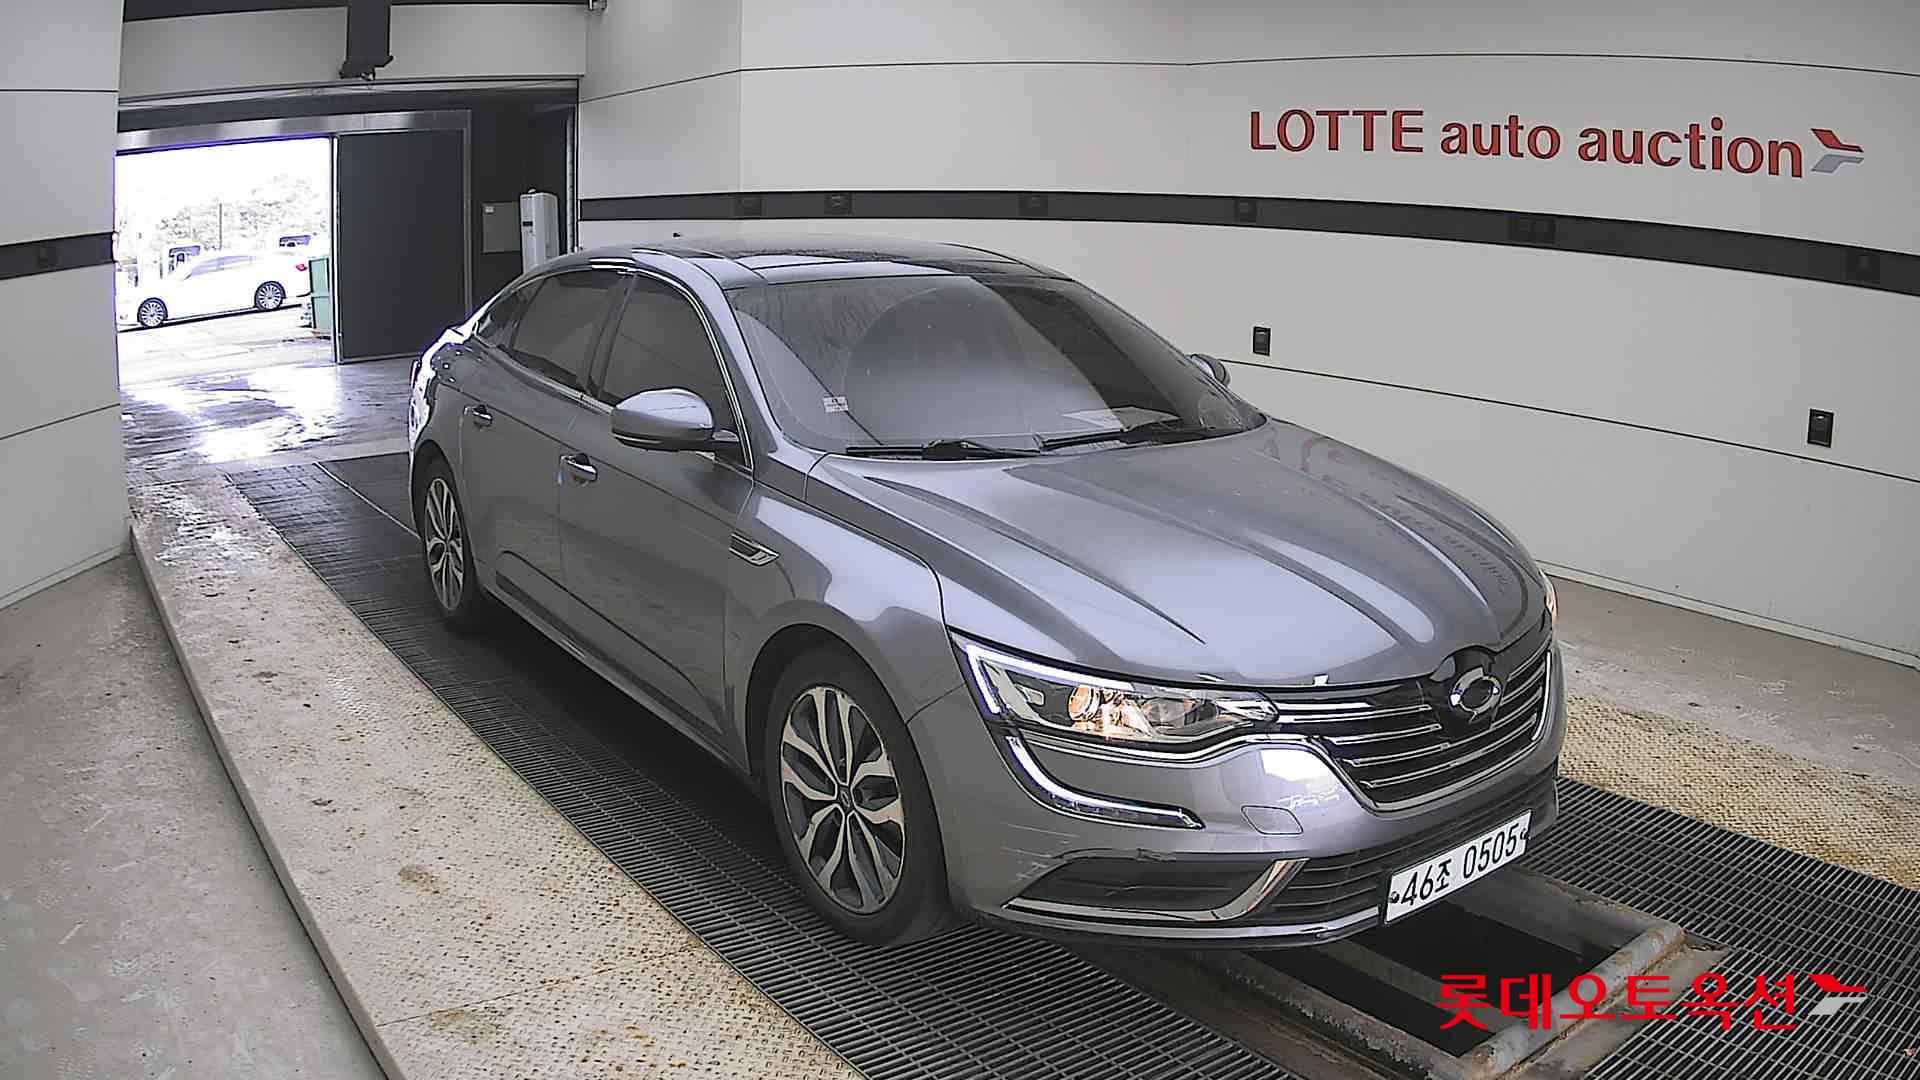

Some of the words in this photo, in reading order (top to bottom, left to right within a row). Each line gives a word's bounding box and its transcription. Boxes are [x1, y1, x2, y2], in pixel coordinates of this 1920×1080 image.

[1251, 109, 1424, 153] LOTTE
[1441, 115, 1561, 159] auto
[1578, 117, 1803, 178] auction
[1400, 858, 1452, 906] 46조
[1463, 823, 1520, 879] 0505
